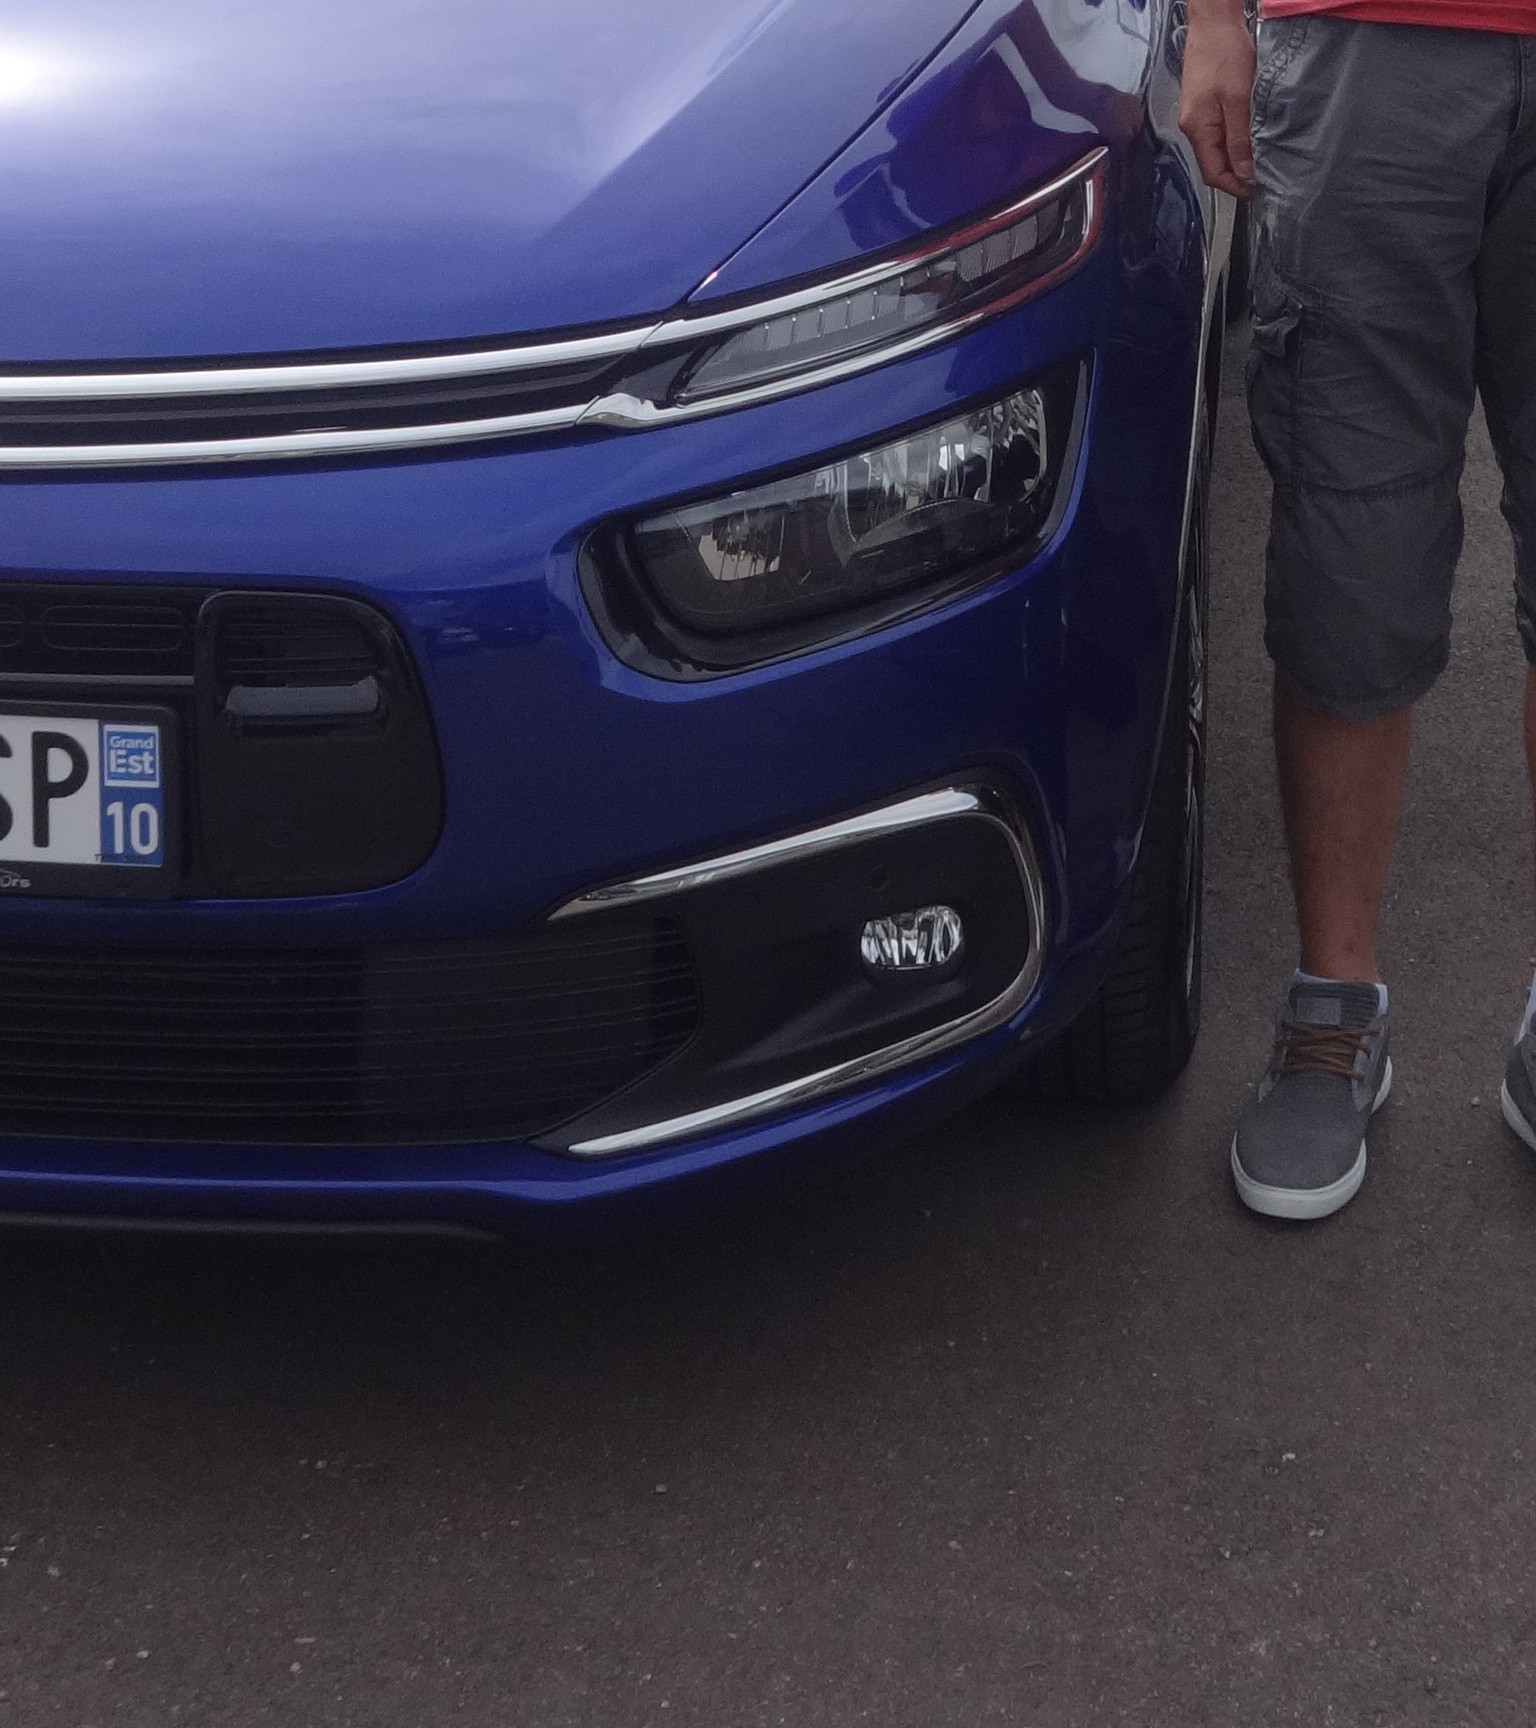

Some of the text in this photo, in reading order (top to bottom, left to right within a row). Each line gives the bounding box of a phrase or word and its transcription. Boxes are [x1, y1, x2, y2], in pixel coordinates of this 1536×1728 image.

[109, 735, 154, 749] Grand
[109, 749, 155, 774] Est
[106, 801, 158, 855] 10
